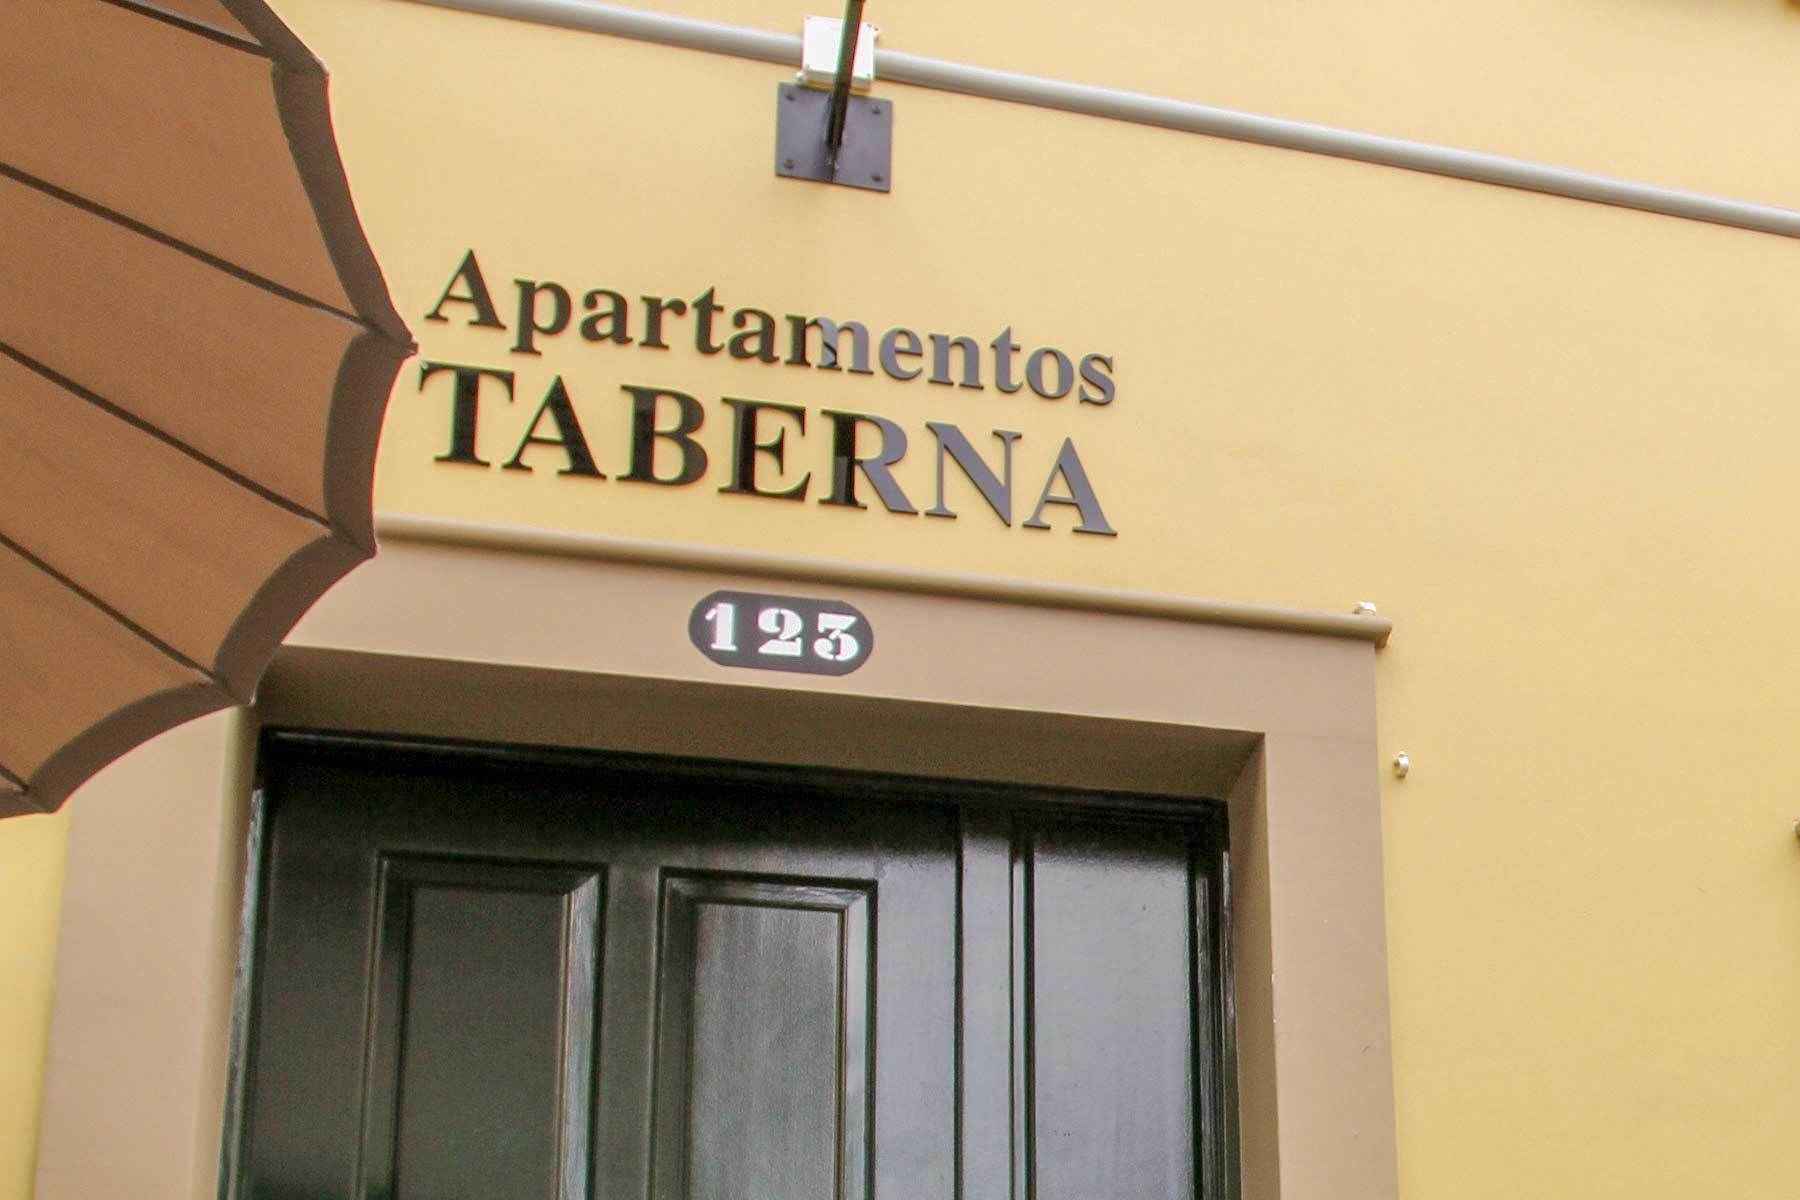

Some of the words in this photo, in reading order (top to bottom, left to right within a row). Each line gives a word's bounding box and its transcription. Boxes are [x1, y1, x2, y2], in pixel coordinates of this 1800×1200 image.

[425, 249, 1116, 406] Apartamentos
[419, 360, 1118, 537] TABERNA
[705, 602, 859, 661] 123
